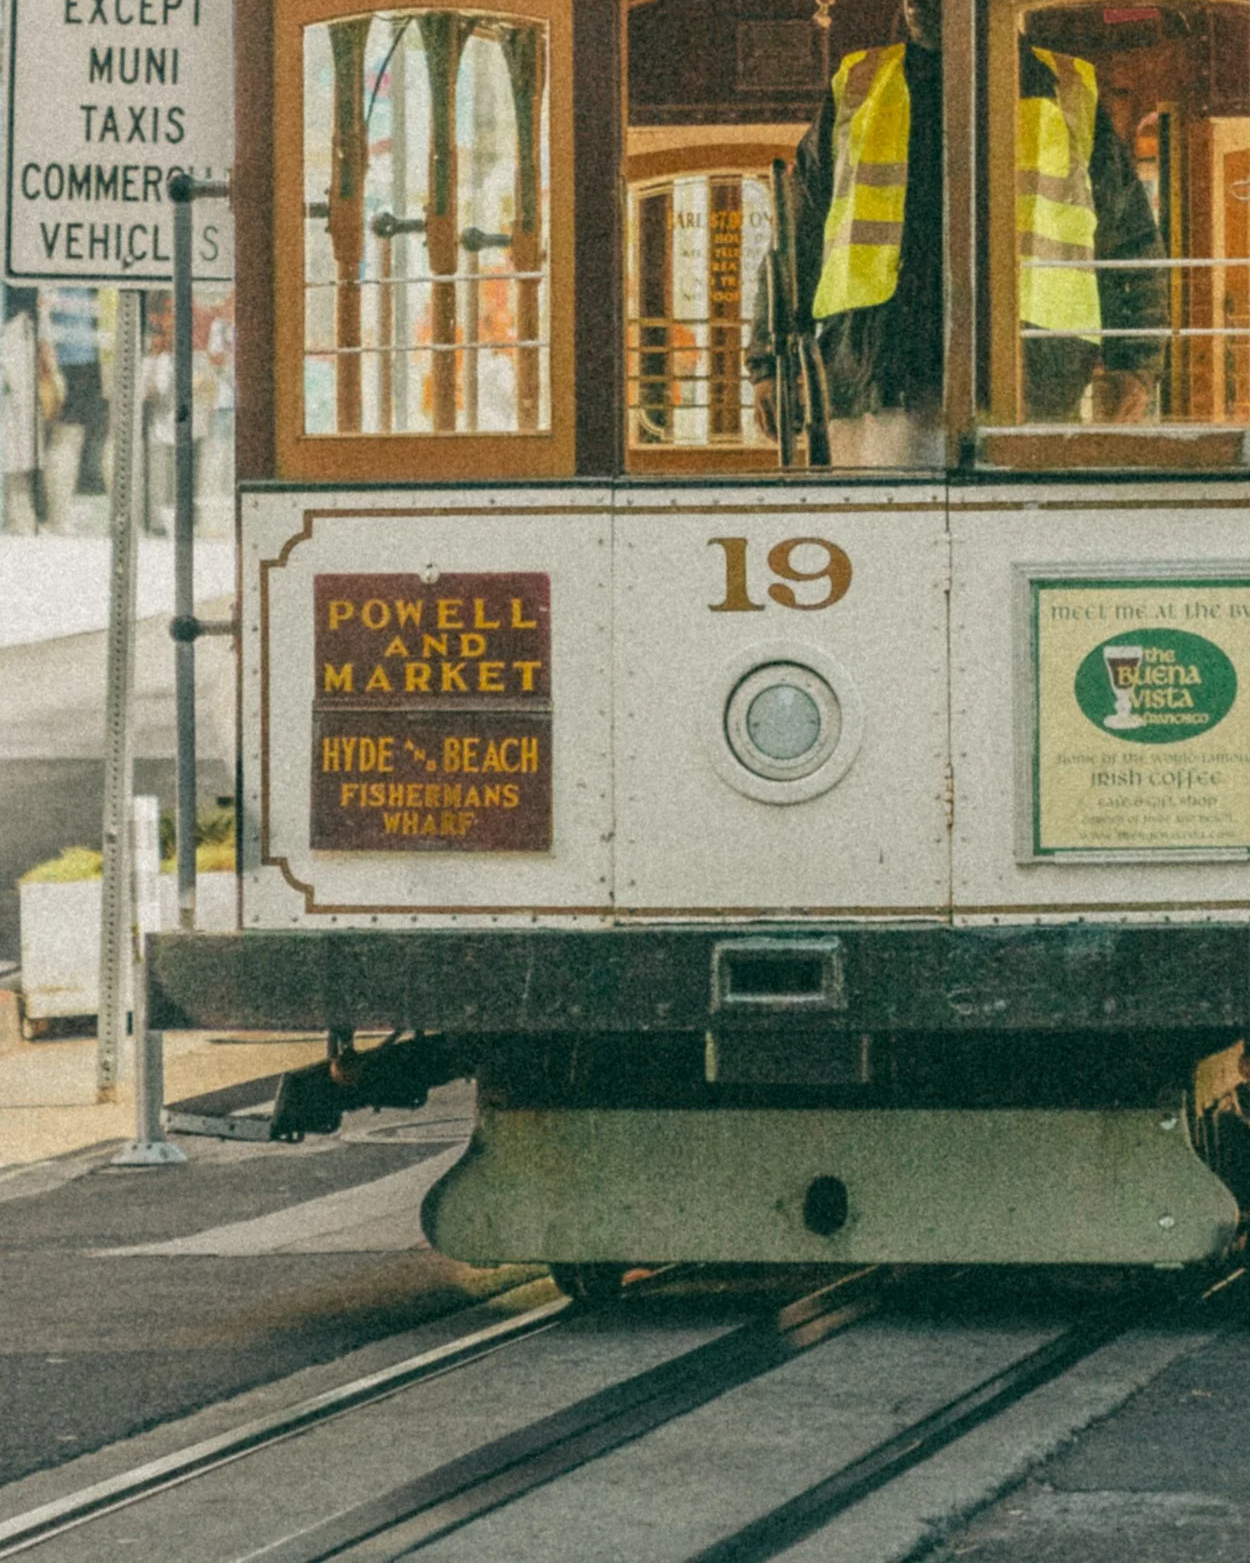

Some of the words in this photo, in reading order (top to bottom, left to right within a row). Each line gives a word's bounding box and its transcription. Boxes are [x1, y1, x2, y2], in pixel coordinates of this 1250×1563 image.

[88, 47, 180, 84] MUNI
[80, 105, 185, 144] TAXIS
[21, 162, 231, 201] COMMER
[41, 222, 220, 261] VEHICLS
[707, 536, 854, 613] 19
[328, 598, 538, 631] POWELL
[383, 633, 487, 659] AND
[323, 660, 543, 694] MARKET
[322, 737, 394, 774] HYDE
[444, 737, 540, 774] BEACH
[340, 782, 520, 809] FISHERMANS
[384, 812, 476, 837] WHARF
